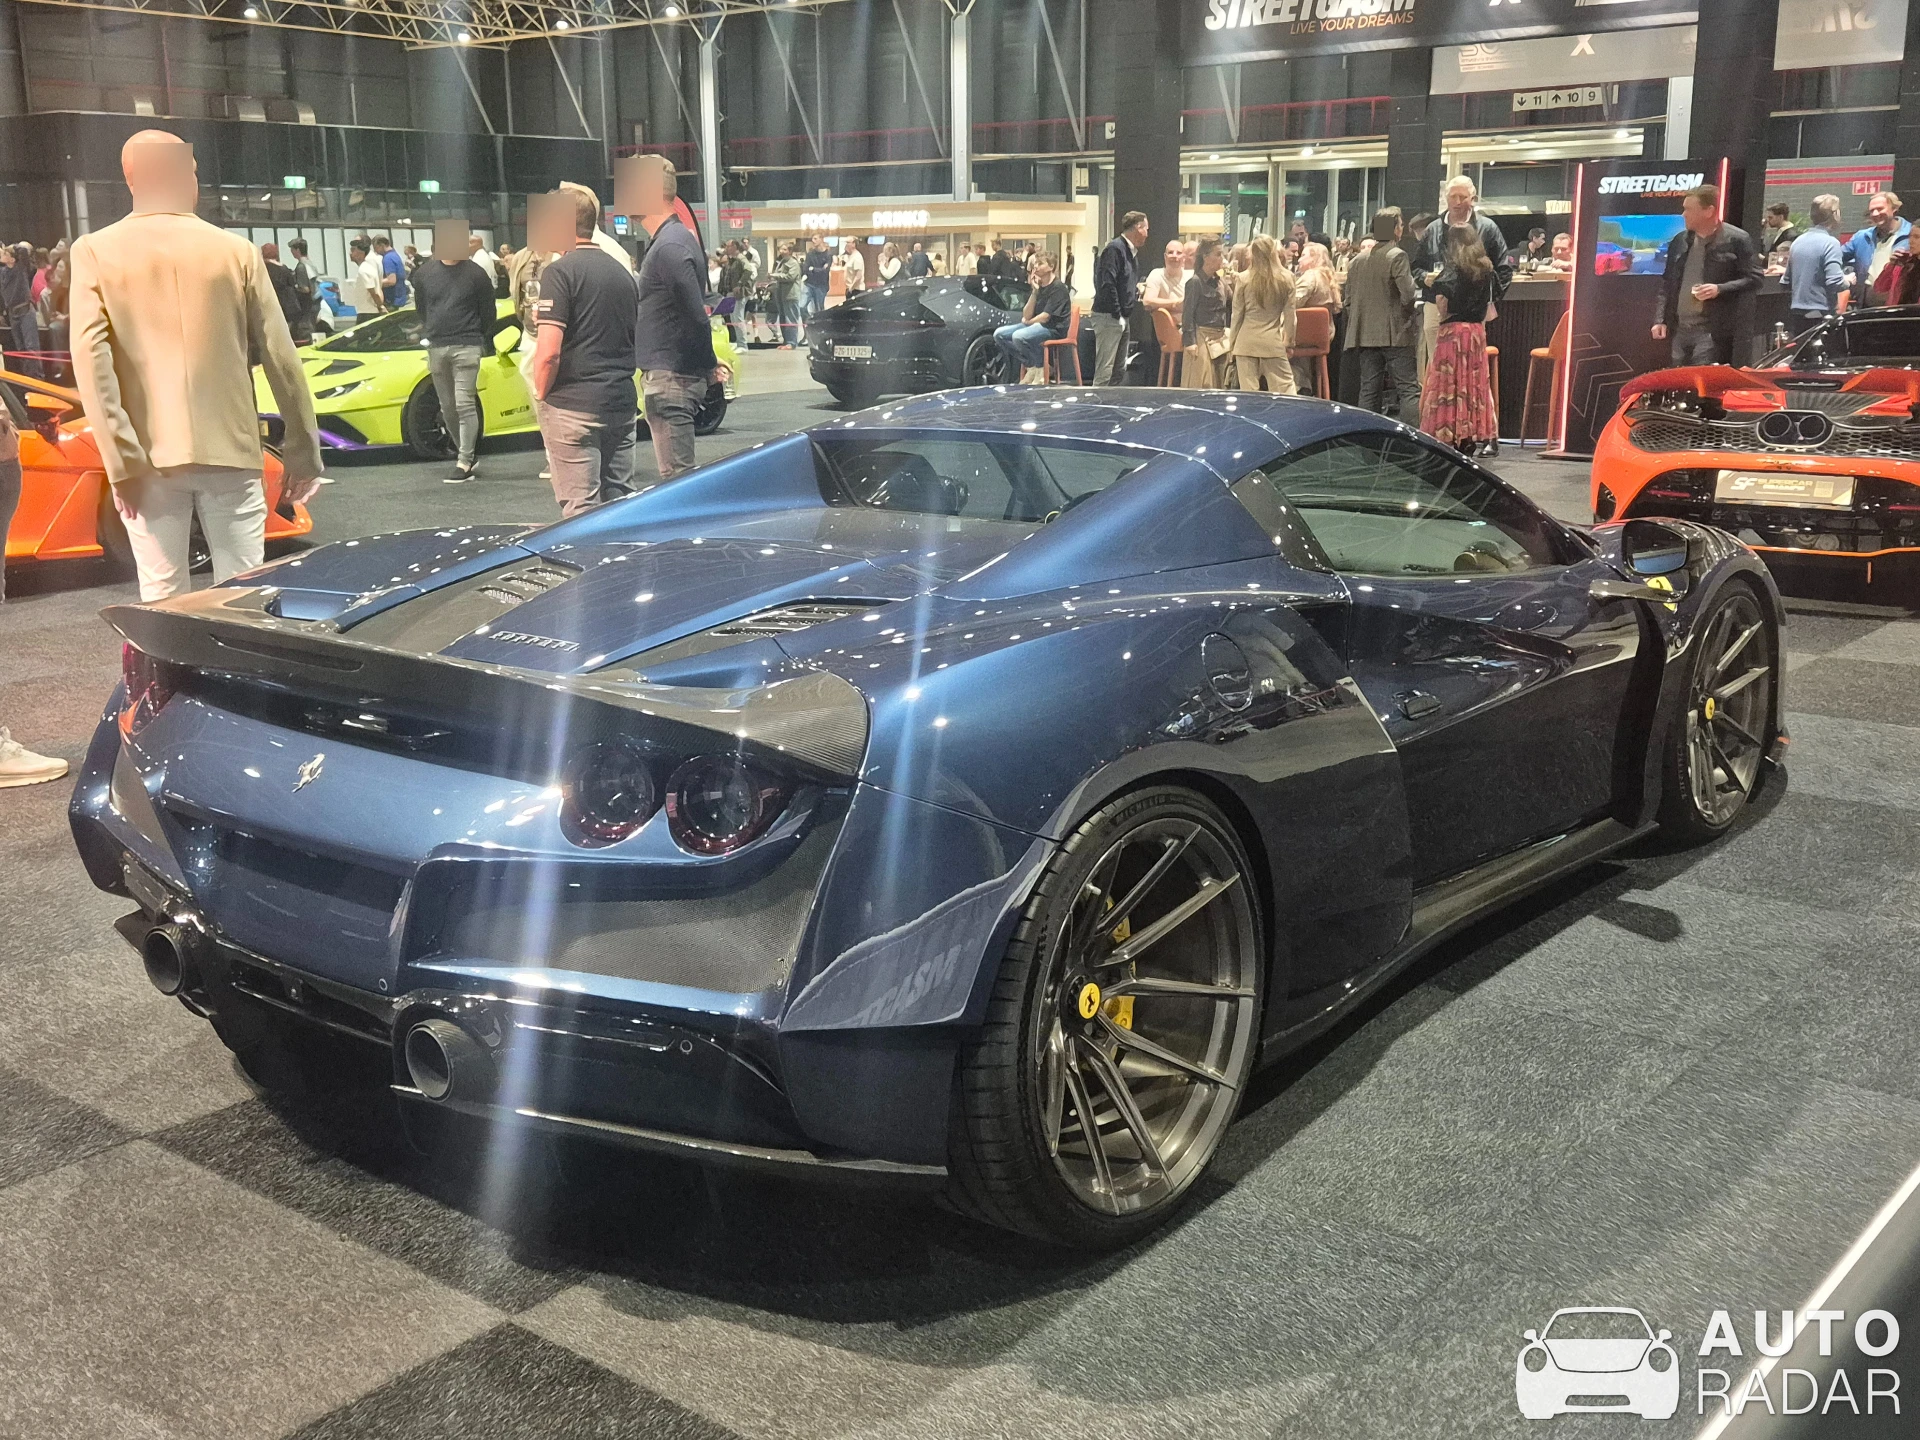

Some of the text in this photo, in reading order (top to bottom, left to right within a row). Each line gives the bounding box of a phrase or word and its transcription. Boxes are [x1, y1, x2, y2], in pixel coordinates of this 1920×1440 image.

[1290, 11, 1414, 35] LIVE YOUR DREAMS
[1532, 91, 1596, 106] 11 10 9
[1598, 173, 1704, 194] STREETGASM
[872, 210, 930, 229] DRINKS
